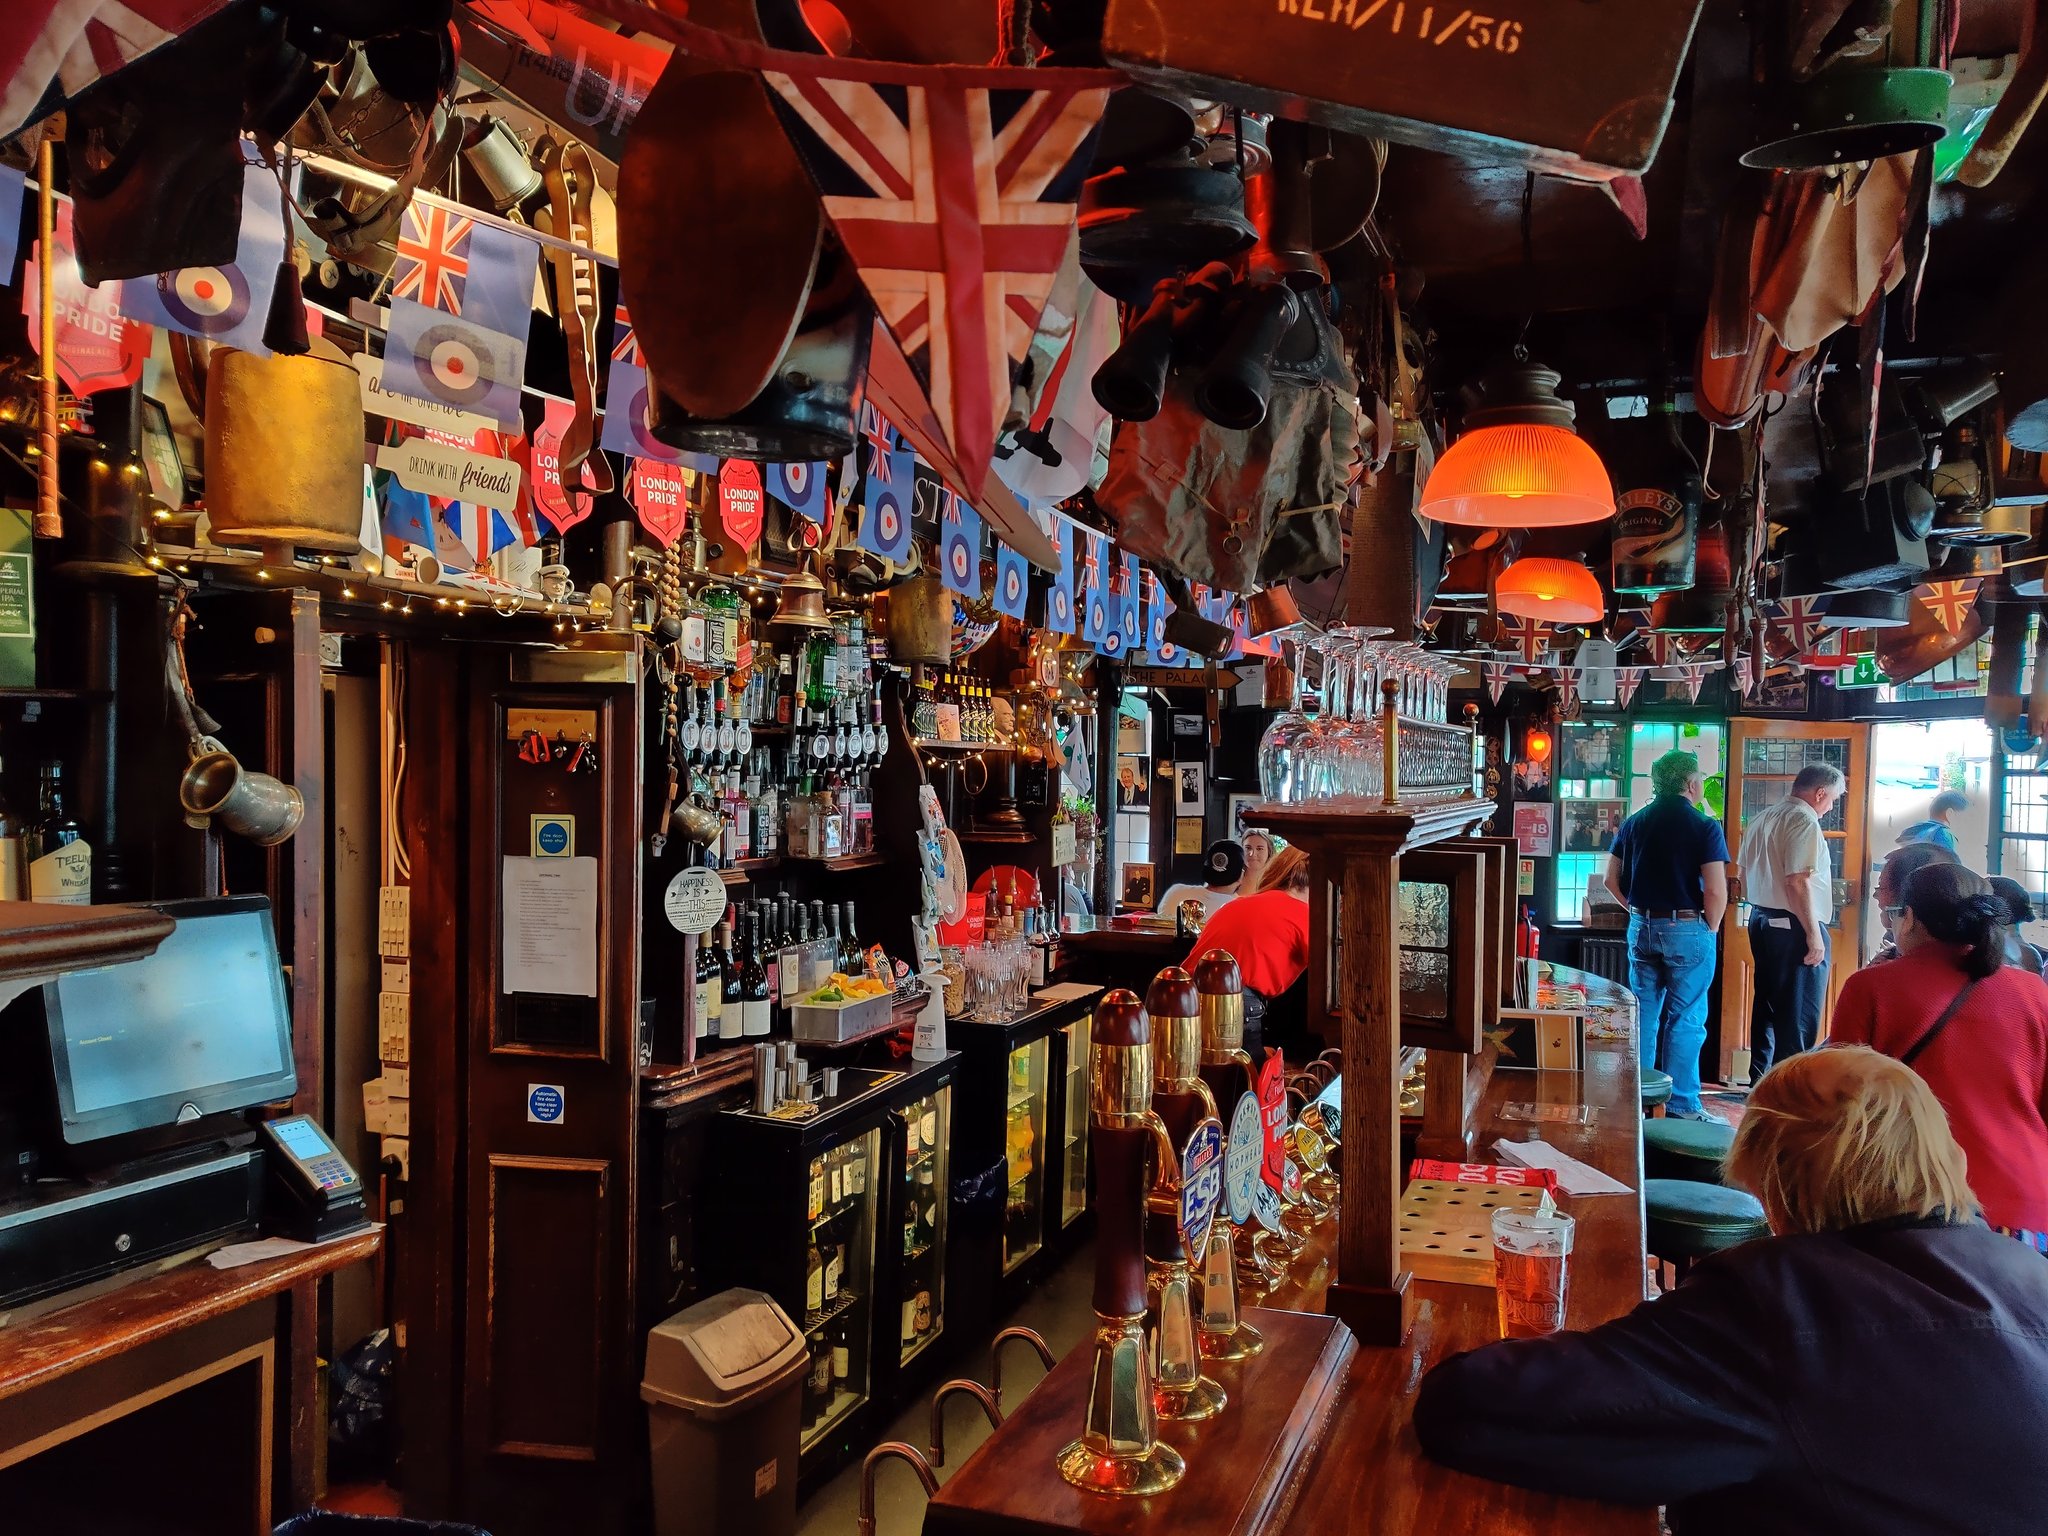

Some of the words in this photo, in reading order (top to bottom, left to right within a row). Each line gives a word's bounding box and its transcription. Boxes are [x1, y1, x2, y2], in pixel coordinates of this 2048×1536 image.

[54, 303, 124, 343] PRIDE
[409, 456, 435, 478] DRINK
[437, 464, 457, 480] WITH
[459, 461, 512, 494] friends
[639, 475, 682, 494] LONDON
[647, 490, 677, 506] PRIDE
[724, 487, 759, 501] LONDON
[1619, 491, 1676, 511] AILEYS
[730, 501, 755, 513] PRIDE
[1618, 515, 1664, 530] ORIGINAL
[395, 567, 416, 579] GUINNE
[1134, 671, 1156, 683] THE
[1532, 822, 1548, 834] 18
[680, 877, 714, 888] HAPPINESS
[693, 888, 701, 898] IS
[689, 899, 706, 910] THIS
[689, 912, 706, 924] WAY
[1267, 1104, 1287, 1127] LON
[1229, 1142, 1263, 1173] HOPHEAD
[1184, 1163, 1220, 1226] ESB
